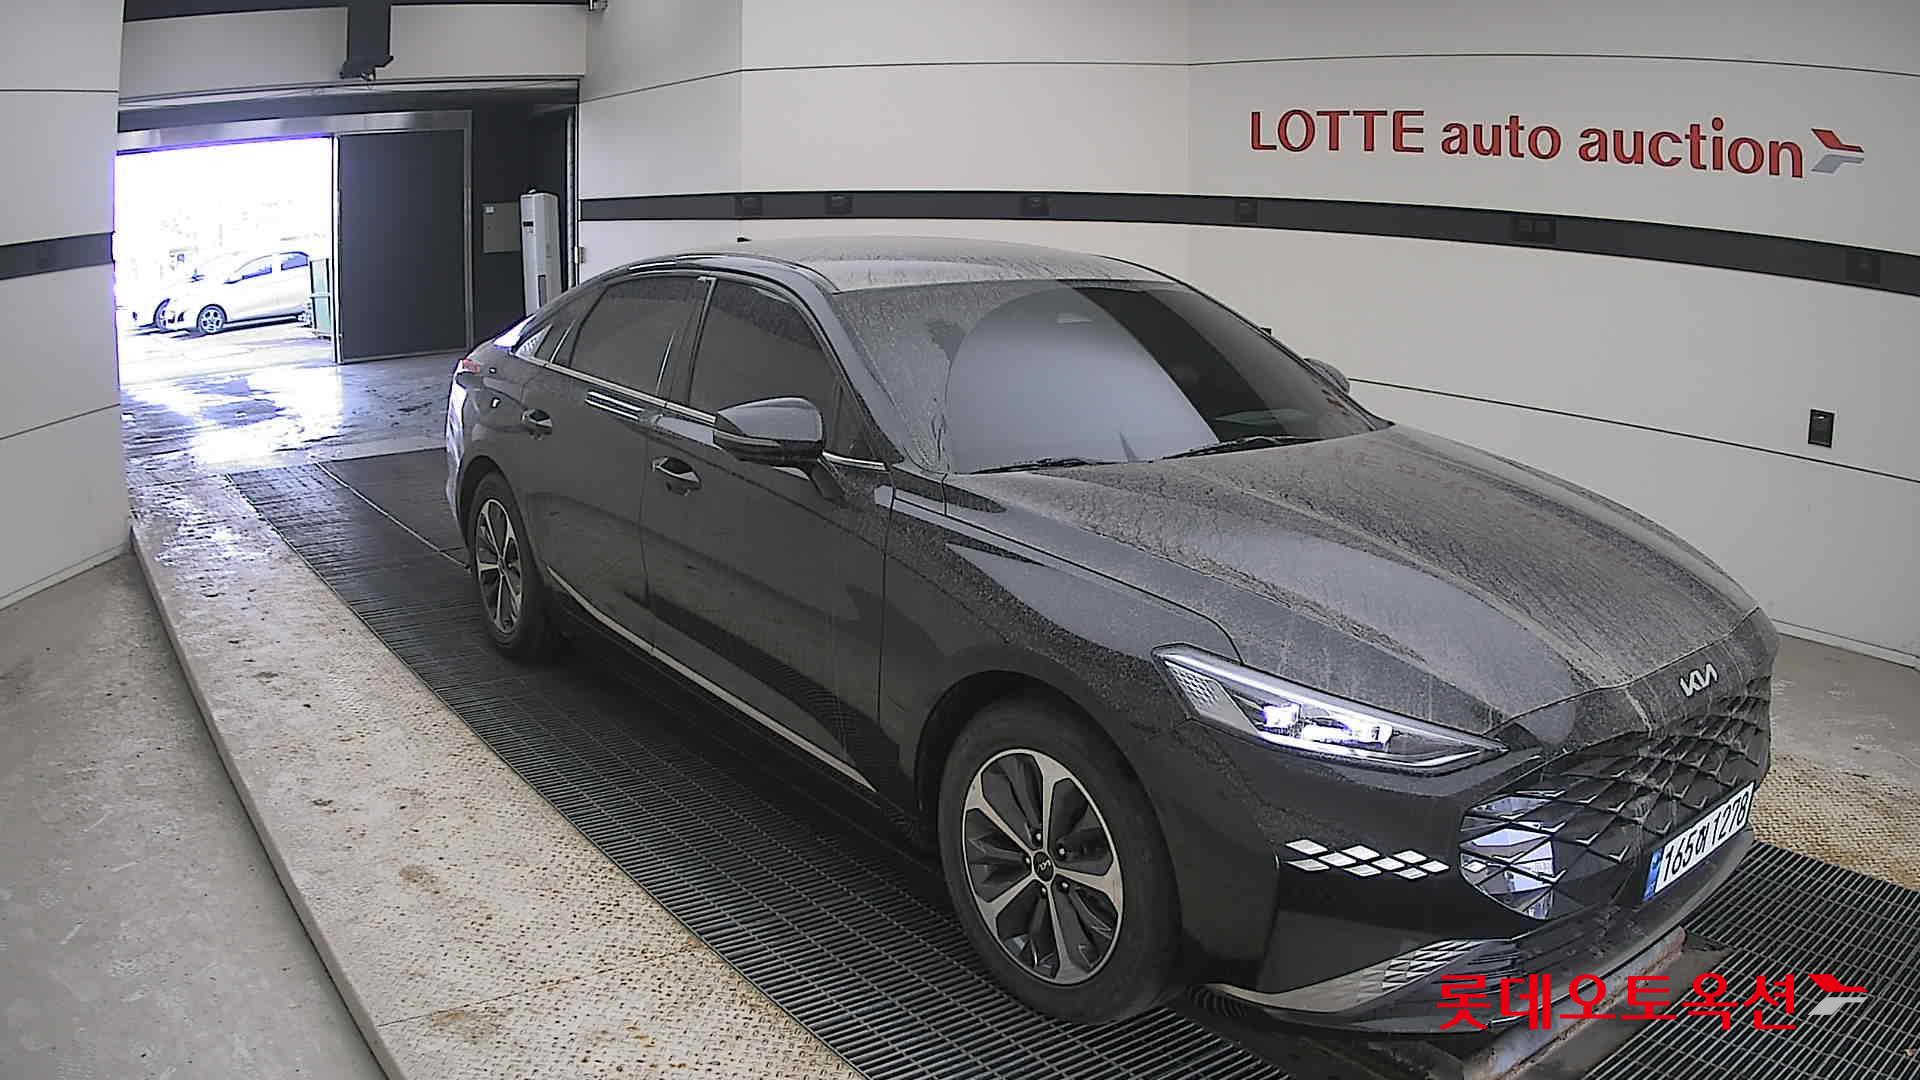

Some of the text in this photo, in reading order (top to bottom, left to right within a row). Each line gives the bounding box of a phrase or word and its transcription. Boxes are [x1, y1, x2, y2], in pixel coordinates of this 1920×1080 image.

[1251, 110, 1804, 178] LOTTE auto auction
[1711, 791, 1749, 845] 1278
